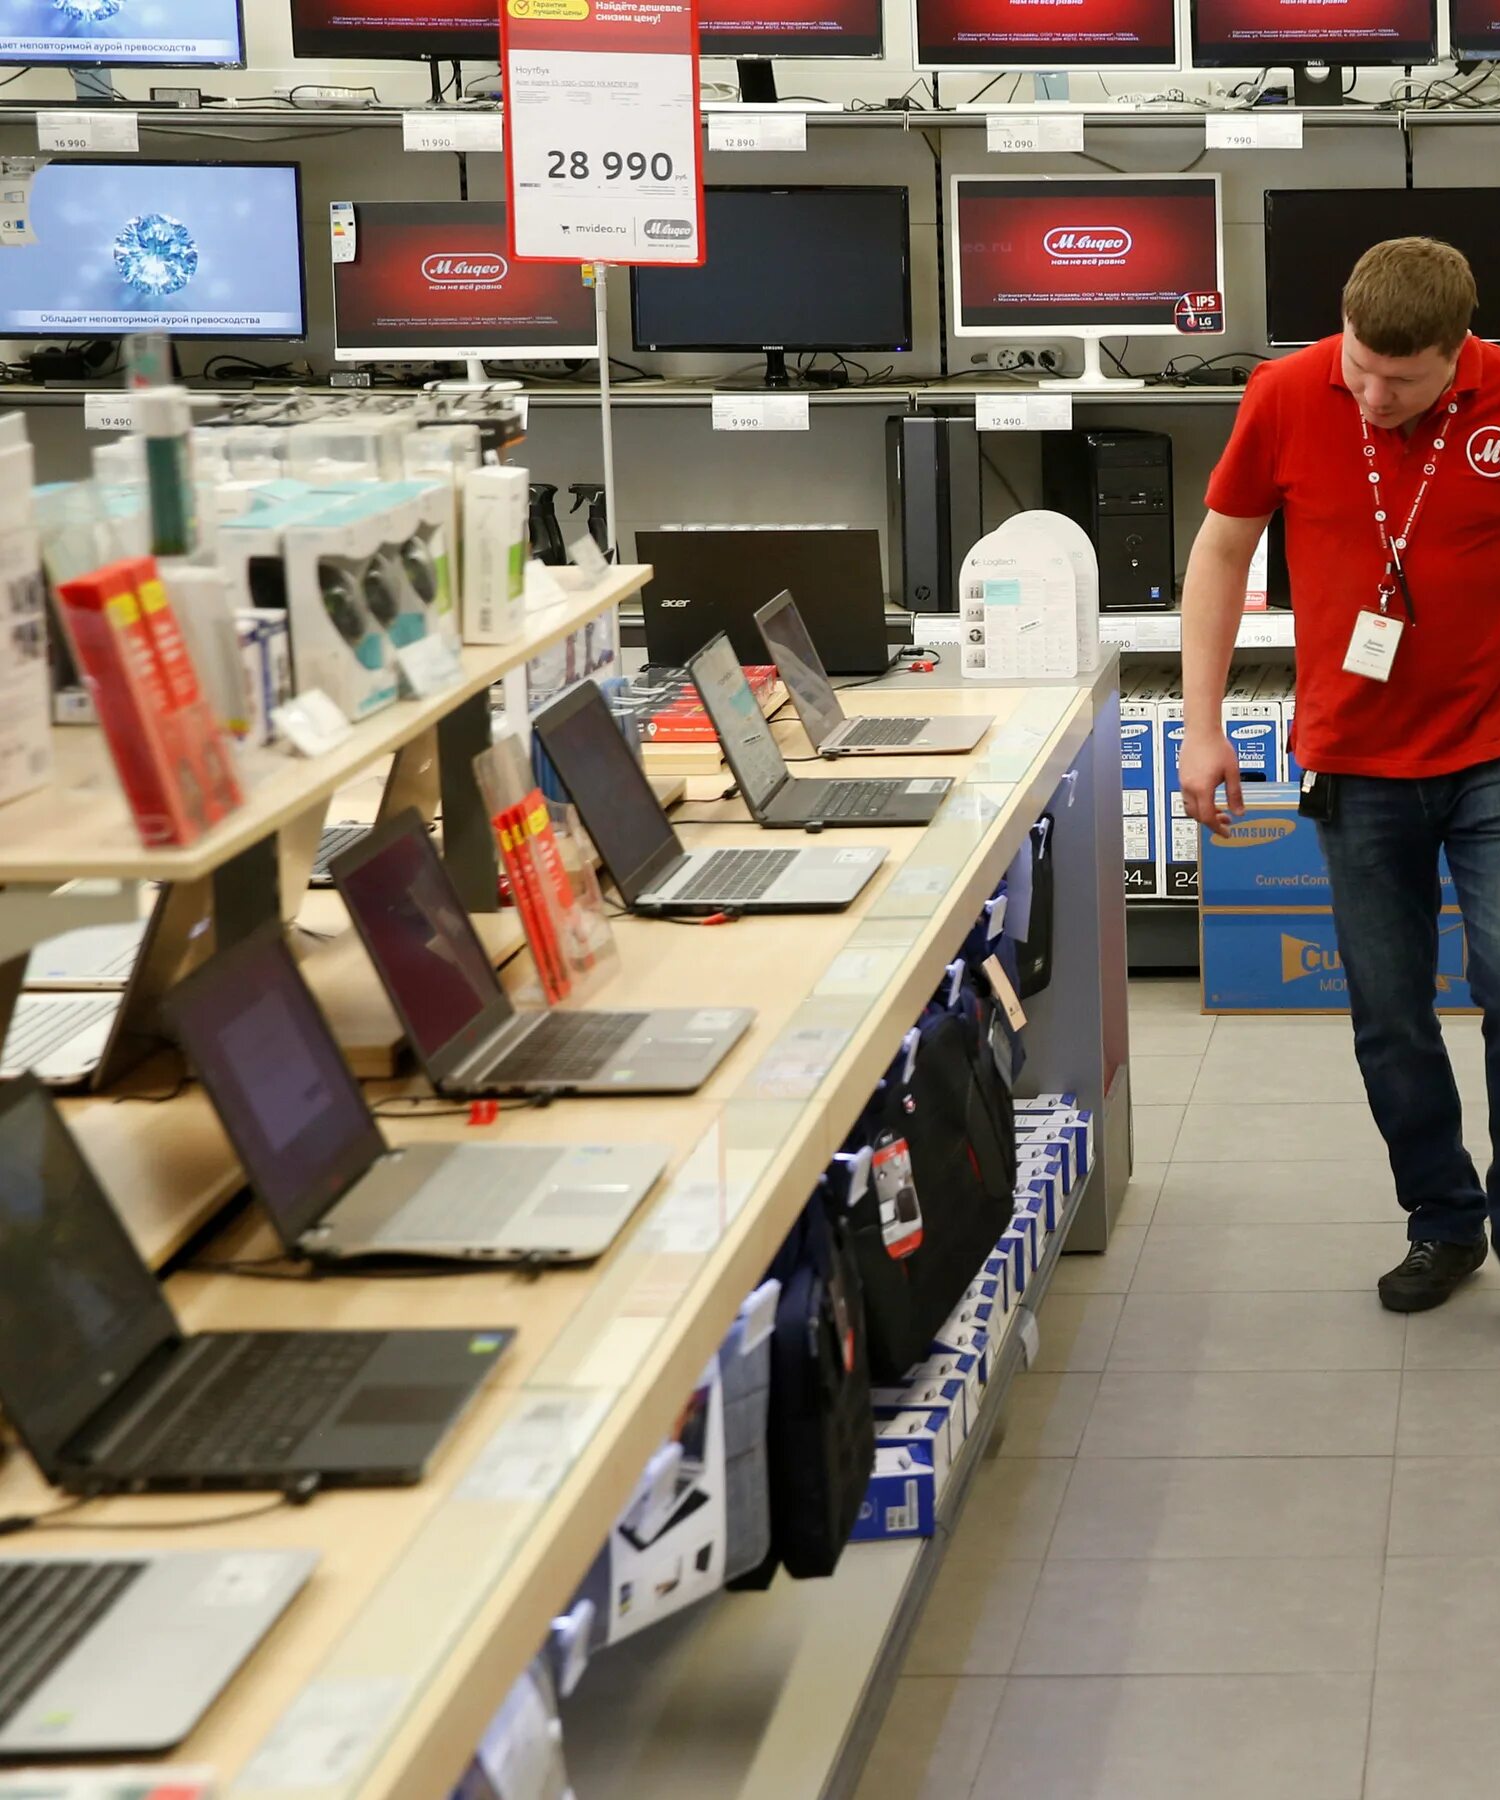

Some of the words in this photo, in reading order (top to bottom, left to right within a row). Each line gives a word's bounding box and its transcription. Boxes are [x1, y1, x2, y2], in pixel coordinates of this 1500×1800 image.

[533, 1, 567, 9] Гарантия
[595, 1, 637, 13] Найдёте
[639, 5, 682, 14] дешевле
[533, 8, 562, 16] лучшей
[595, 13, 632, 22] снизим
[634, 13, 661, 25] цену!
[20, 42, 92, 51] неповторимой
[93, 43, 122, 53] аурой
[124, 43, 196, 53] превосходства
[515, 65, 550, 76] Ноутбук
[55, 139, 65, 148] 16
[421, 139, 429, 147] 11
[725, 139, 735, 147] 12
[1003, 140, 1012, 148] 12
[1226, 137, 1232, 145] 7
[547, 150, 590, 180] 28
[602, 151, 673, 182] 990
[576, 223, 627, 234] mvideo.ru
[1052, 234, 1124, 252] М.видео
[1082, 257, 1097, 265] всё
[430, 260, 500, 277] М.видео
[460, 282, 474, 291] всё
[475, 283, 502, 292] равно
[1196, 294, 1215, 308] IPS
[40, 314, 87, 324] Обладает
[89, 314, 159, 325] неповторимой
[161, 315, 189, 326] аурой
[190, 315, 261, 326] превосходства
[1198, 317, 1212, 326] LG
[101, 418, 110, 427] 19
[113, 418, 132, 427] 490
[732, 418, 739, 427] 9
[992, 418, 1001, 427] 12
[982, 557, 1016, 567] Logitech
[661, 599, 691, 608] acer
[1236, 727, 1267, 735] SAMSUNG
[1238, 742, 1265, 751] LED
[1238, 752, 1265, 760] Monitor
[1229, 827, 1286, 838] AMSUNG
[1255, 874, 1299, 886] Curved
[1301, 874, 1328, 886] Com
